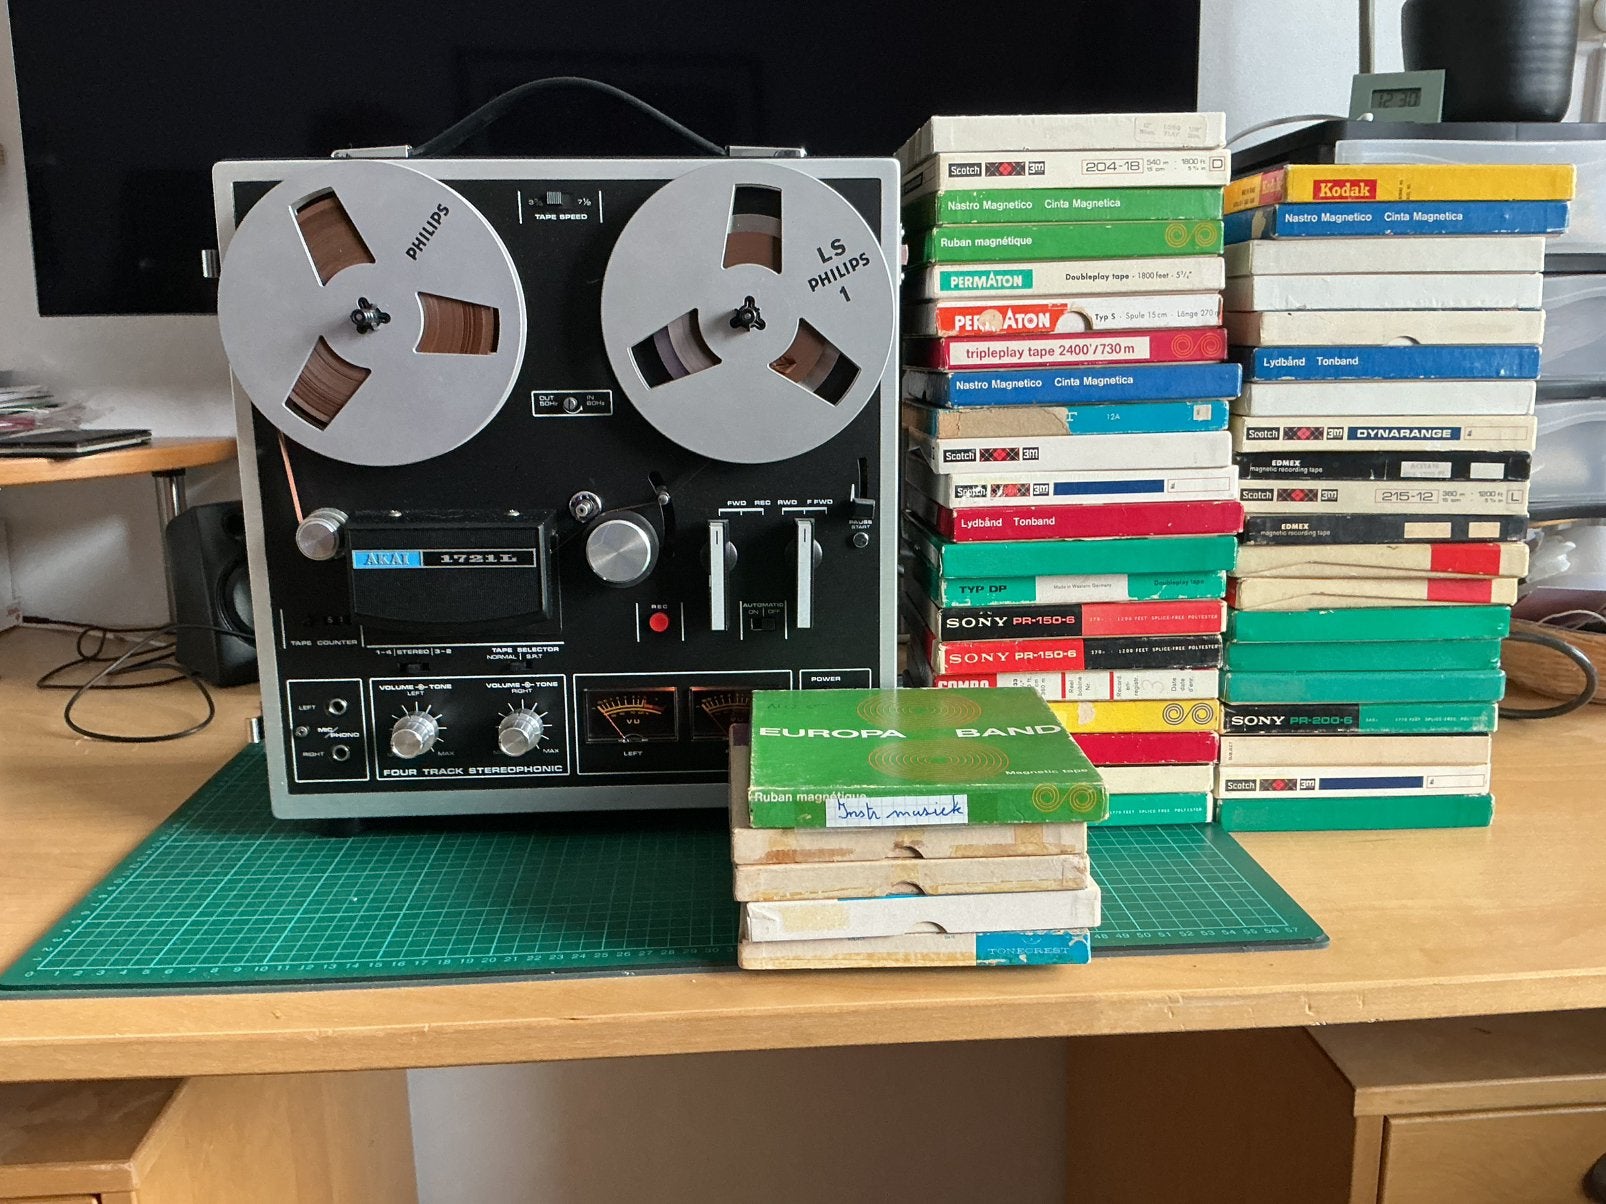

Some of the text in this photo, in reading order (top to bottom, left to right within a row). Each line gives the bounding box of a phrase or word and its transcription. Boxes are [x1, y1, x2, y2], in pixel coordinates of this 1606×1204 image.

[951, 166, 980, 175] Scotch
[1086, 161, 1140, 172] 204-18
[1319, 182, 1370, 197] Kodak
[948, 198, 1121, 211] Nastro Magnetico Cinta Magnetica
[1285, 212, 1463, 223] Nastro Magnetico Cinta Magnetica
[405, 203, 450, 261] PHILIPS
[940, 236, 1033, 247] Ruban magnétique
[816, 238, 847, 264] LS
[807, 252, 871, 292] PHILIPS
[1065, 273, 1110, 282] Doubleplay
[1112, 273, 1130, 281] tape
[1155, 271, 1169, 279] feet
[950, 271, 1022, 288] PERMATON
[839, 286, 852, 302] 1
[954, 307, 1051, 332] PERATON
[1094, 313, 1109, 322] Typ
[1111, 312, 1116, 320] S
[1125, 312, 1145, 321] Spule
[966, 347, 1024, 360] tripleplay
[1028, 347, 1055, 359] tape
[1123, 344, 1135, 354] m
[1263, 356, 1359, 368] Lydbånd Tonband
[956, 375, 1134, 390] Nastro Magnetico Cinta Magnetica
[1248, 429, 1278, 438] Scotch
[1356, 429, 1452, 438] DYNARANGE
[946, 452, 975, 460] Scotch
[1278, 466, 1308, 474] recording
[1242, 491, 1272, 500] Scotch
[1382, 491, 1434, 501] 215-12
[1511, 493, 1520, 502] L
[961, 516, 1056, 528] Lydbånd Tonband
[366, 552, 409, 565] AKAI
[440, 554, 518, 563] 1721L
[959, 585, 1007, 594] TYP DP
[946, 615, 1076, 628] SONY PR-150-6
[949, 650, 1077, 664] SONY PR-150-6
[810, 675, 841, 683] POWER
[1231, 716, 1353, 726] SONY PR-200-6
[759, 724, 1063, 739] EUROPA BAND
[383, 765, 563, 777] FOUR TRACK STEREOPHONIC
[1005, 767, 1088, 776] Magnetic tape
[1227, 781, 1255, 789] Scotch
[754, 791, 793, 802] Ruban
